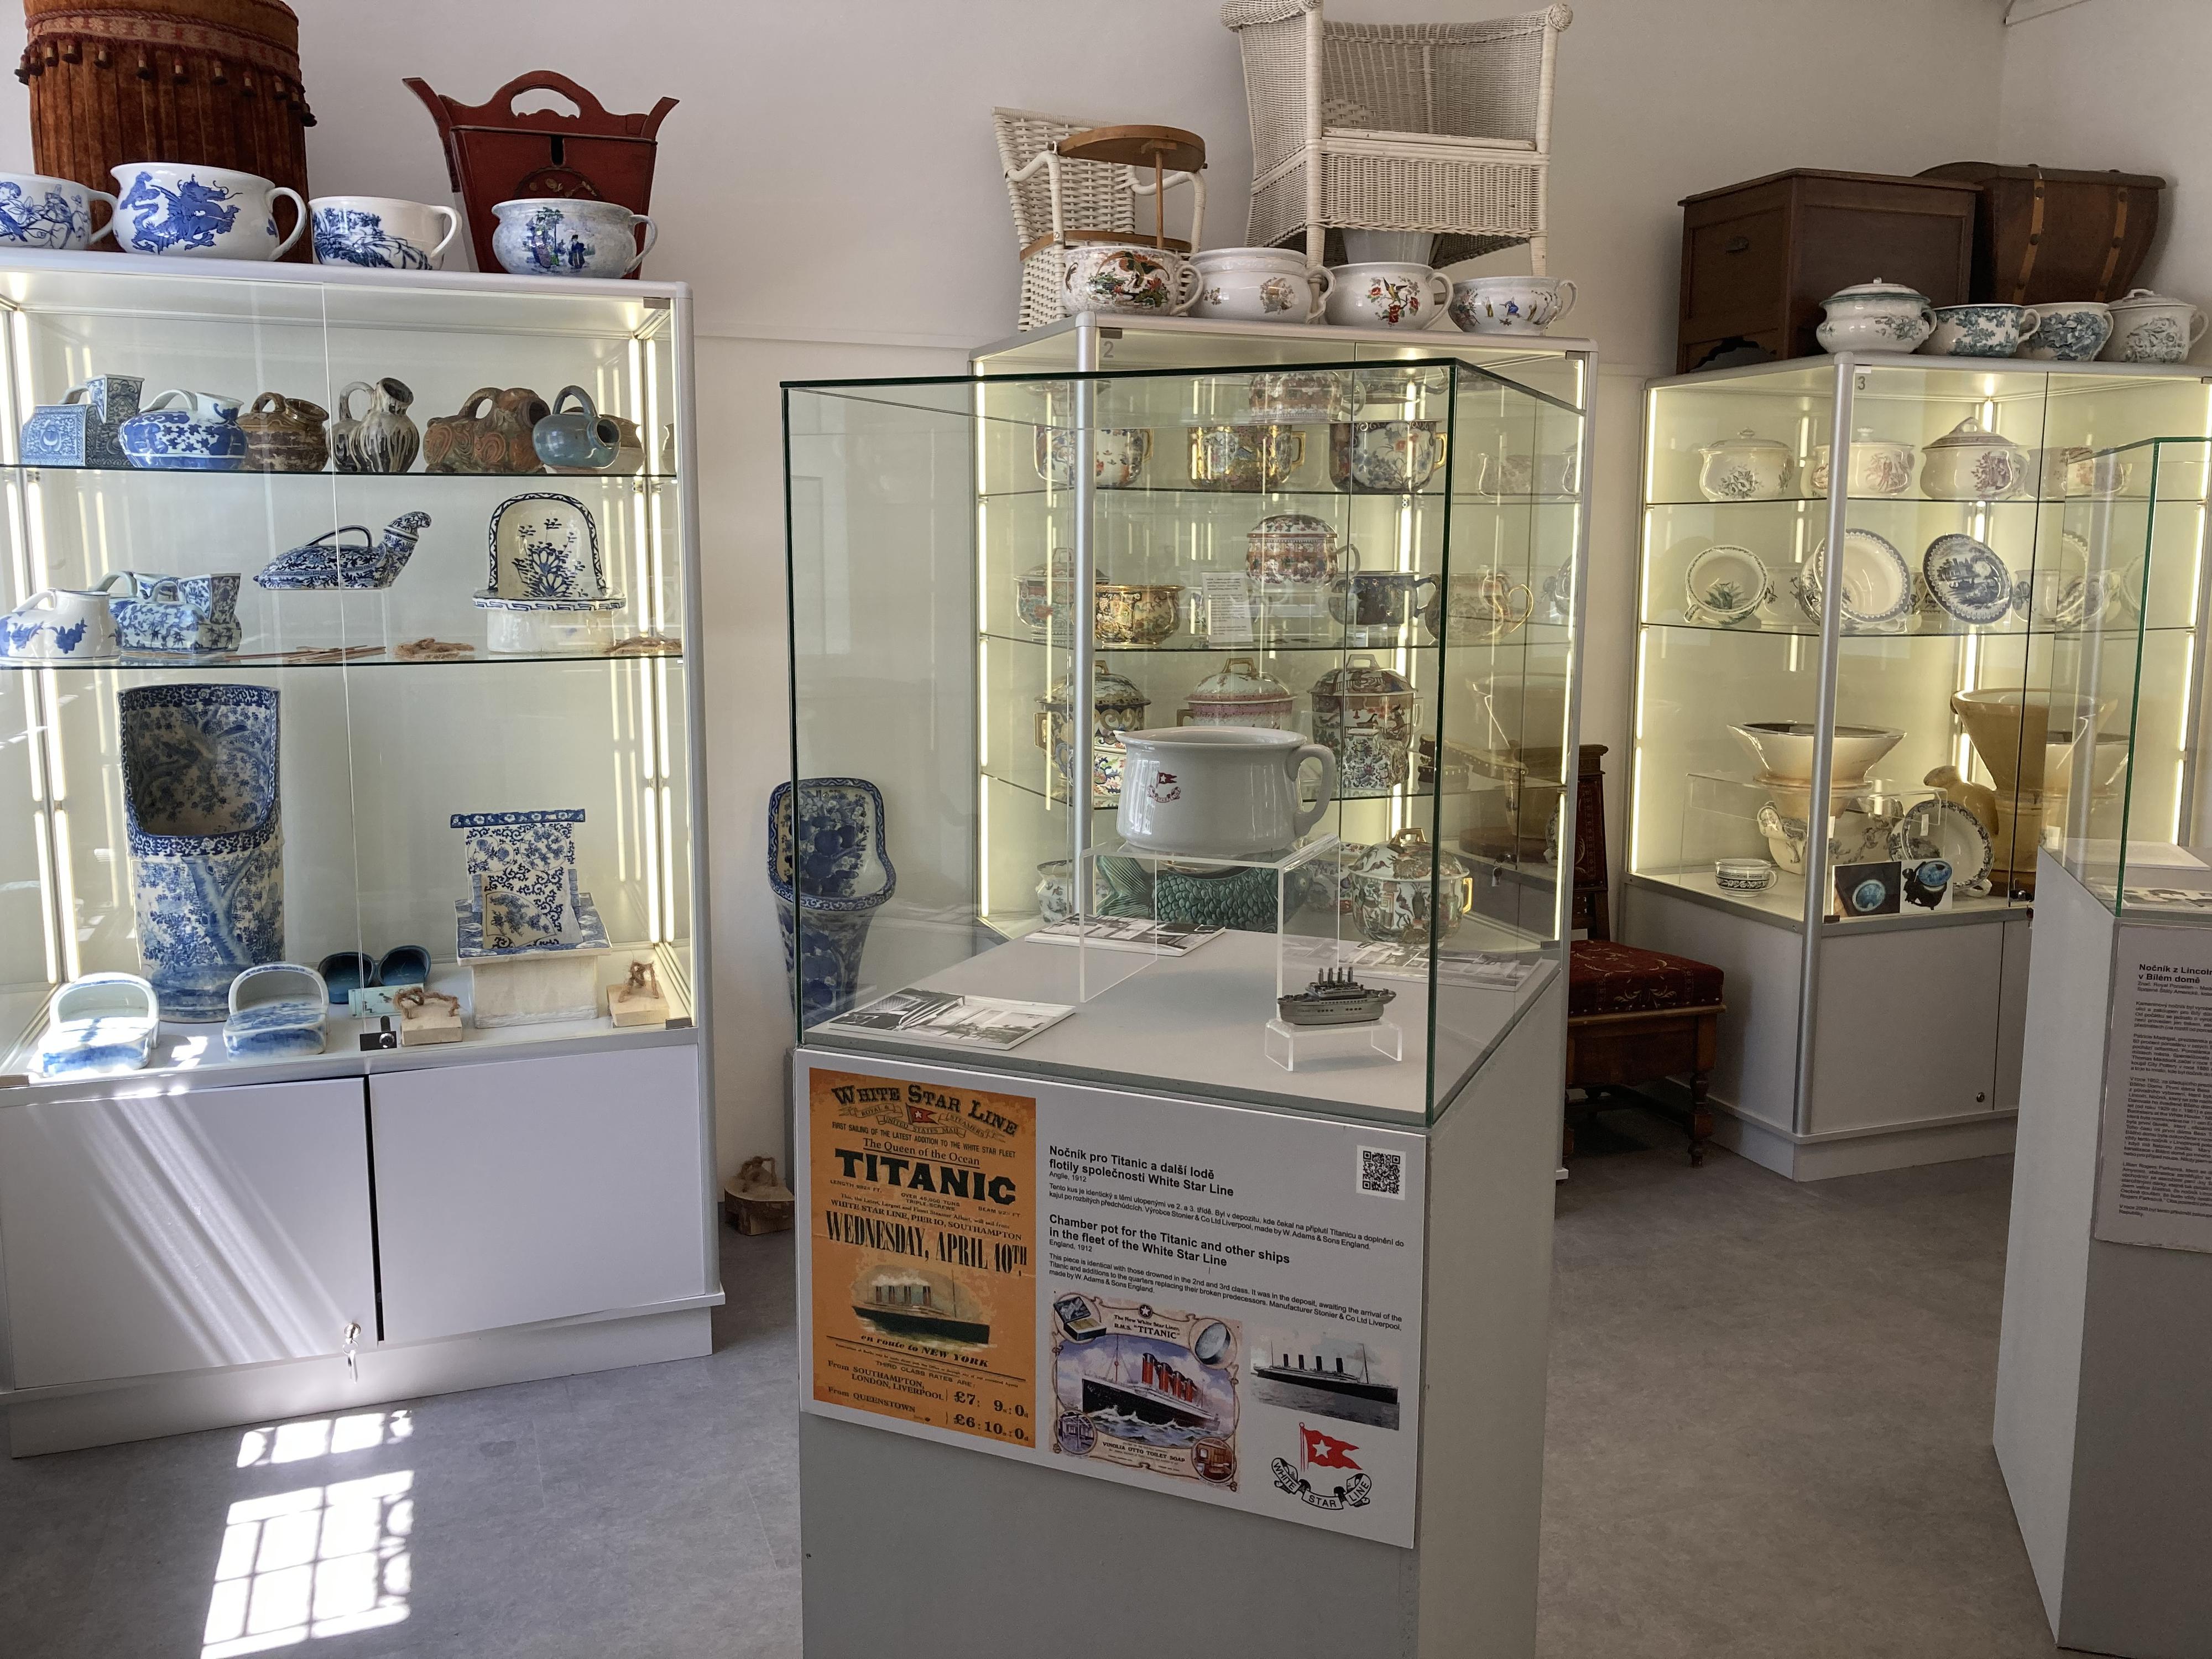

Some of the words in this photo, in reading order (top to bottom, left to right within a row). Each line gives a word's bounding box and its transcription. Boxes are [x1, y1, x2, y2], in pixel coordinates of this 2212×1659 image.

[1103, 341, 1114, 358] 2
[1858, 376, 1865, 390] 3
[2138, 964, 2171, 972] Nočník
[2146, 973, 2172, 982] Bílém
[831, 1085, 901, 1105] WHITE
[908, 1083, 961, 1113] STAR
[968, 1099, 1019, 1137] LINE
[861, 1106, 882, 1117] ROYAL
[832, 1121, 848, 1130] FIRST
[848, 1124, 869, 1134] SAILING
[879, 1129, 890, 1138] THE
[891, 1131, 912, 1141] LATEST
[940, 1139, 948, 1147] TO
[950, 1140, 961, 1149] THE
[962, 1142, 979, 1152] WHITE
[982, 1146, 997, 1155] STAR
[998, 1149, 1015, 1158] FLEET
[862, 1137, 881, 1151] The
[883, 1141, 915, 1155] Queen
[918, 1147, 928, 1156] of
[931, 1149, 946, 1160] the
[948, 1152, 979, 1165] Ocean
[834, 1147, 1016, 1204] TITANIC
[1048, 1170, 1070, 1181] Anglie,
[1071, 1173, 1087, 1182] 1912
[1049, 1145, 1087, 1160] Nočník
[1089, 1153, 1108, 1164] pro
[1110, 1154, 1147, 1169] Titanic
[1150, 1162, 1157, 1171] a
[1160, 1162, 1187, 1176] další
[1190, 1166, 1214, 1180] lodě
[1048, 1158, 1079, 1174] flotily
[1082, 1165, 1145, 1182] společnosti
[1147, 1173, 1180, 1188] White
[1182, 1178, 1207, 1192] Star
[1209, 1182, 1234, 1196] Line
[826, 1210, 928, 1261] WEDNESDAY,
[935, 1231, 988, 1269] APRIL
[947, 1221, 1021, 1241] SOUTHAMPTON
[1049, 1213, 1098, 1230] Chamber
[1100, 1224, 1119, 1234] pot
[1120, 1225, 1137, 1237] for
[1139, 1229, 1157, 1241] the
[1159, 1232, 1197, 1248] Titanic
[1200, 1241, 1222, 1252] and
[1224, 1244, 1255, 1258] other
[1258, 1249, 1290, 1264] ships
[1048, 1238, 1076, 1250] England,
[1077, 1244, 1092, 1252] 1912
[1049, 1226, 1059, 1238] in
[1061, 1229, 1079, 1240] the
[1081, 1232, 1105, 1245] fleet
[1107, 1237, 1119, 1248] of
[1121, 1239, 1139, 1251] the
[1141, 1241, 1173, 1257] White
[1176, 1248, 1201, 1261] Star
[1202, 1253, 1227, 1266] Line
[1048, 1269, 1066, 1277] made
[1066, 1271, 1074, 1280] by
[1083, 1274, 1104, 1284] Adams
[1110, 1279, 1127, 1288] Sons
[1127, 1282, 1155, 1293] England.
[1048, 1252, 1062, 1261] This
[1062, 1255, 1079, 1264] piece
[1087, 1259, 1112, 1270] identical
[1126, 1266, 1144, 1275] those
[1145, 1270, 1172, 1280] drowned
[1192, 1277, 1204, 1286] 2nd
[1218, 1282, 1230, 1291] 3rd
[1231, 1285, 1250, 1295] class.
[1279, 1293, 1290, 1302] the
[1291, 1296, 1317, 1307] deposit,
[1318, 1302, 1347, 1313] awaiting
[1348, 1306, 1359, 1314] the
[1360, 1310, 1381, 1318] arrival
[1391, 1313, 1402, 1322] the
[1048, 1260, 1069, 1270] Titanic
[1082, 1267, 1109, 1279] additions
[1110, 1271, 1117, 1280] to
[1128, 1275, 1154, 1285] quarters
[1154, 1280, 1183, 1292] replacing
[1183, 1285, 1198, 1293] their
[1199, 1287, 1222, 1297] broken
[1269, 1300, 1313, 1314] Manufacturer
[1313, 1308, 1338, 1318] Stonier
[1344, 1312, 1355, 1322] Co
[1356, 1316, 1368, 1324] Ltd
[1368, 1318, 1402, 1331] Liverpool,
[827, 1359, 849, 1371] From
[876, 1338, 906, 1349] route
[905, 1343, 920, 1352] to
[920, 1345, 950, 1358] NEW
[950, 1351, 988, 1368] YORK
[827, 1386, 849, 1397] From
[853, 1392, 915, 1412] QUEENSTOWN
[851, 1373, 891, 1389] LONDON,
[893, 1383, 944, 1400] LIVERPOOL
[1102, 1441, 1125, 1450] VINOLIA
[1128, 1446, 1144, 1454] OTTO
[1145, 1450, 1167, 1459] TOILET
[1273, 1461, 1297, 1491] WHITE
[1308, 1494, 1338, 1509] STAR
[1348, 1480, 1369, 1503] LINE
